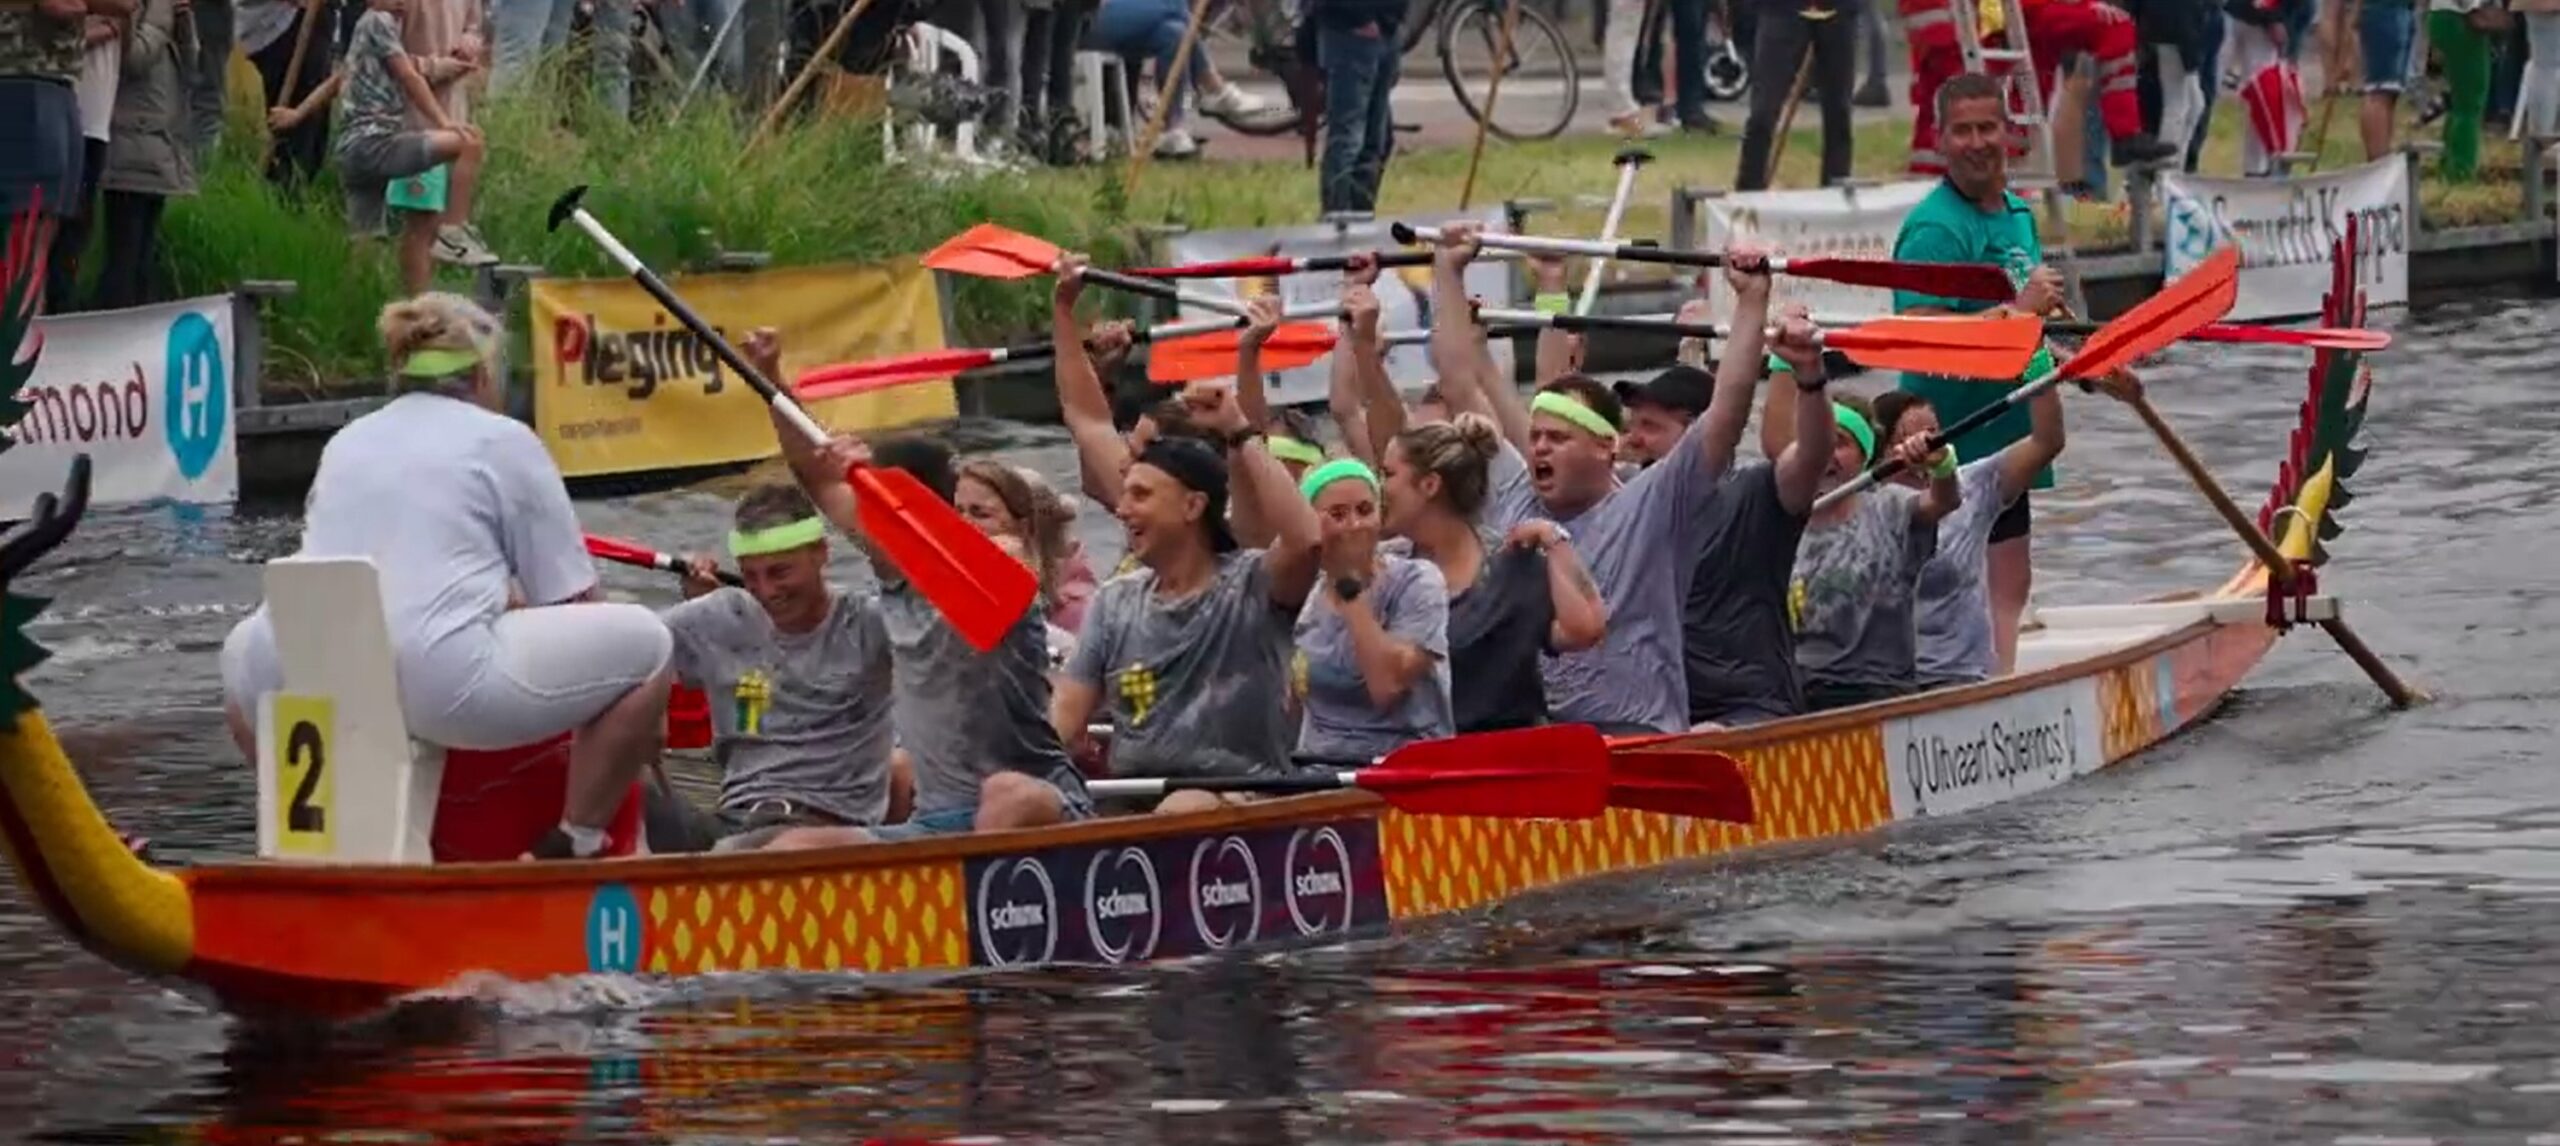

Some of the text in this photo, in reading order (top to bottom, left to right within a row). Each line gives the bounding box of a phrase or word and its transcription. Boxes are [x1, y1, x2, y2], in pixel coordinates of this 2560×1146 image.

[2212, 186, 2402, 284] Smurfit Kppa
[553, 312, 725, 400] Pleging
[288, 720, 325, 833] 2
[1922, 718, 2066, 794] Uitvaart Spierings
[601, 906, 627, 966] H
